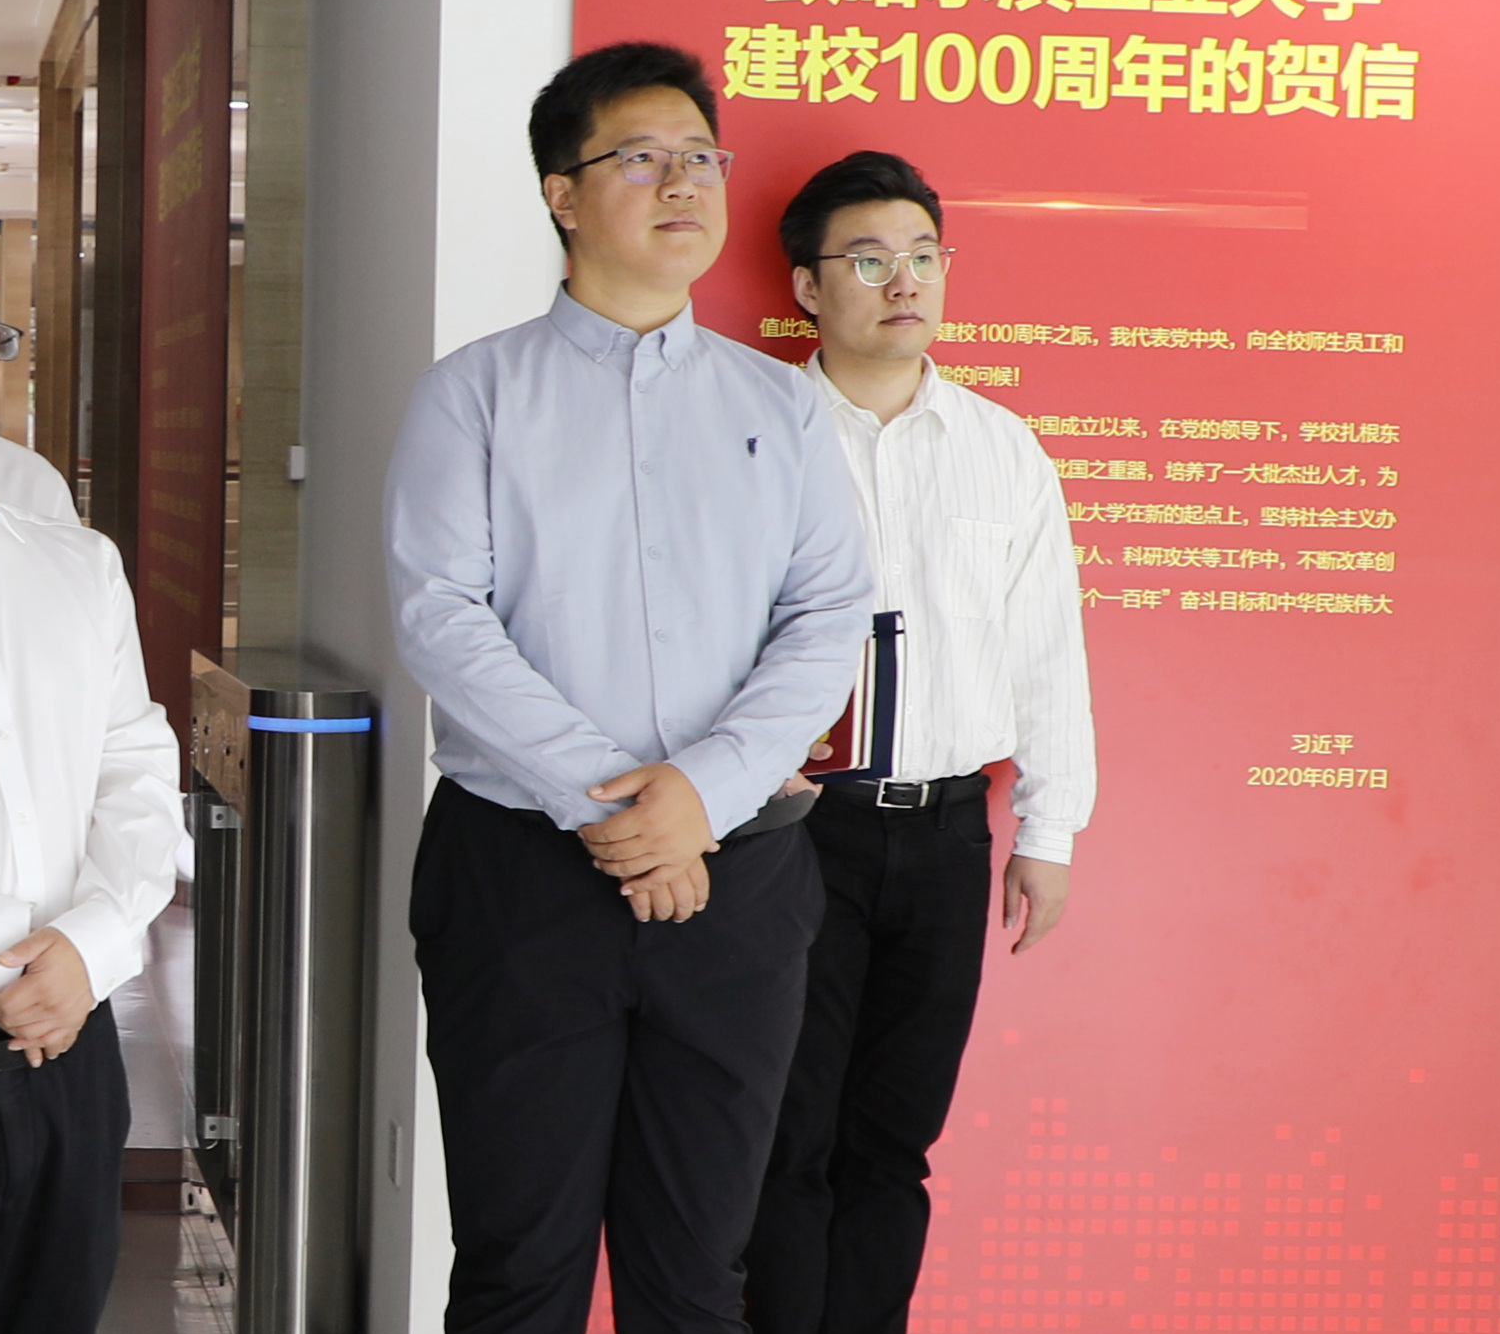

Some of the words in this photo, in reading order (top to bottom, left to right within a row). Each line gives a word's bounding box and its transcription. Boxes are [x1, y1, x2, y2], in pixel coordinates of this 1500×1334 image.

[722, 22, 1420, 121] 建校100周年的贺信
[1290, 733, 1354, 756] 习近平
[1247, 767, 1389, 790] 2020年6月7日
